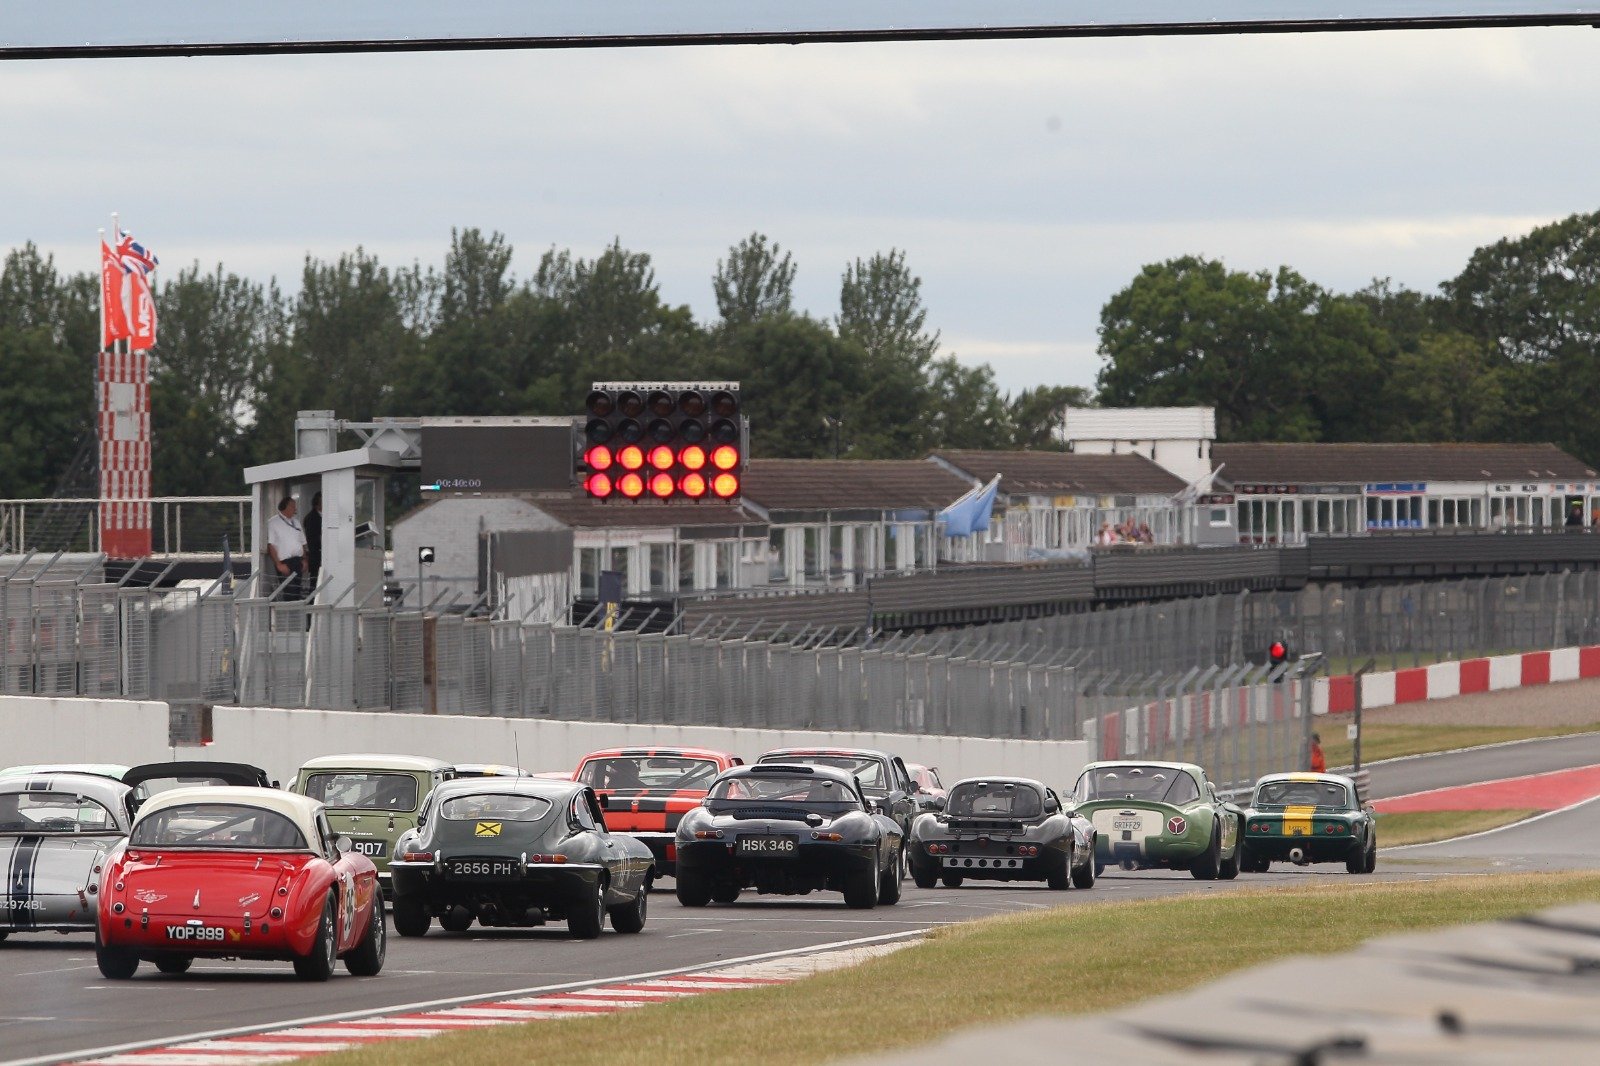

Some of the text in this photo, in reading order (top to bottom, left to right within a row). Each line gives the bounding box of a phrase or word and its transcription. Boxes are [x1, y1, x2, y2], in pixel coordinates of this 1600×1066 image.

[435, 479, 481, 487] 00:40:00
[355, 842, 382, 855] 907
[742, 840, 793, 851] HSK 346
[454, 862, 511, 875] 2656 PH
[167, 925, 224, 940] YOP 999
